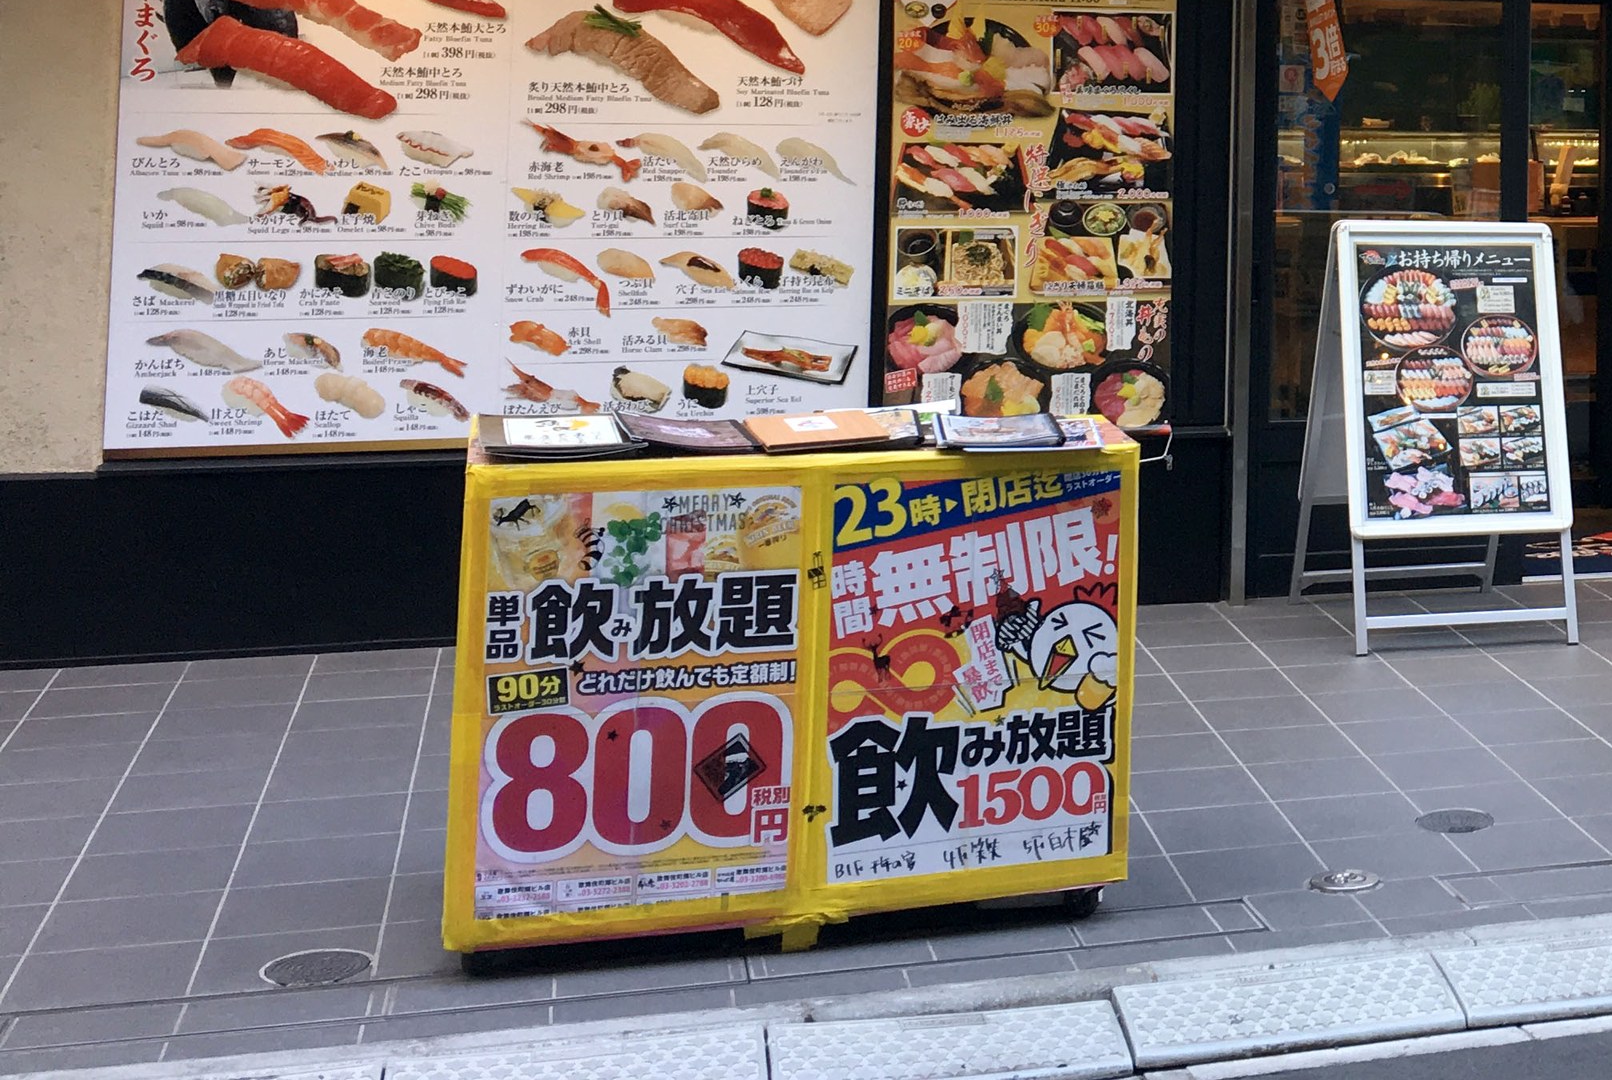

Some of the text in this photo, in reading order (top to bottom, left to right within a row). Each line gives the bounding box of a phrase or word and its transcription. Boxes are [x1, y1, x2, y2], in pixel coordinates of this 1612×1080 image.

[1398, 250, 1532, 268] お持ち帰りメニュー
[678, 493, 731, 514] MERRY
[530, 573, 798, 661] 飲み放題
[831, 559, 873, 640] 時間
[486, 595, 521, 660] 単品
[496, 673, 562, 703] 90分
[578, 661, 797, 694] どれだけ飲んでも定額制!
[493, 700, 786, 853] 800
[753, 786, 791, 806] 税別
[829, 707, 1107, 849] 飲み放題
